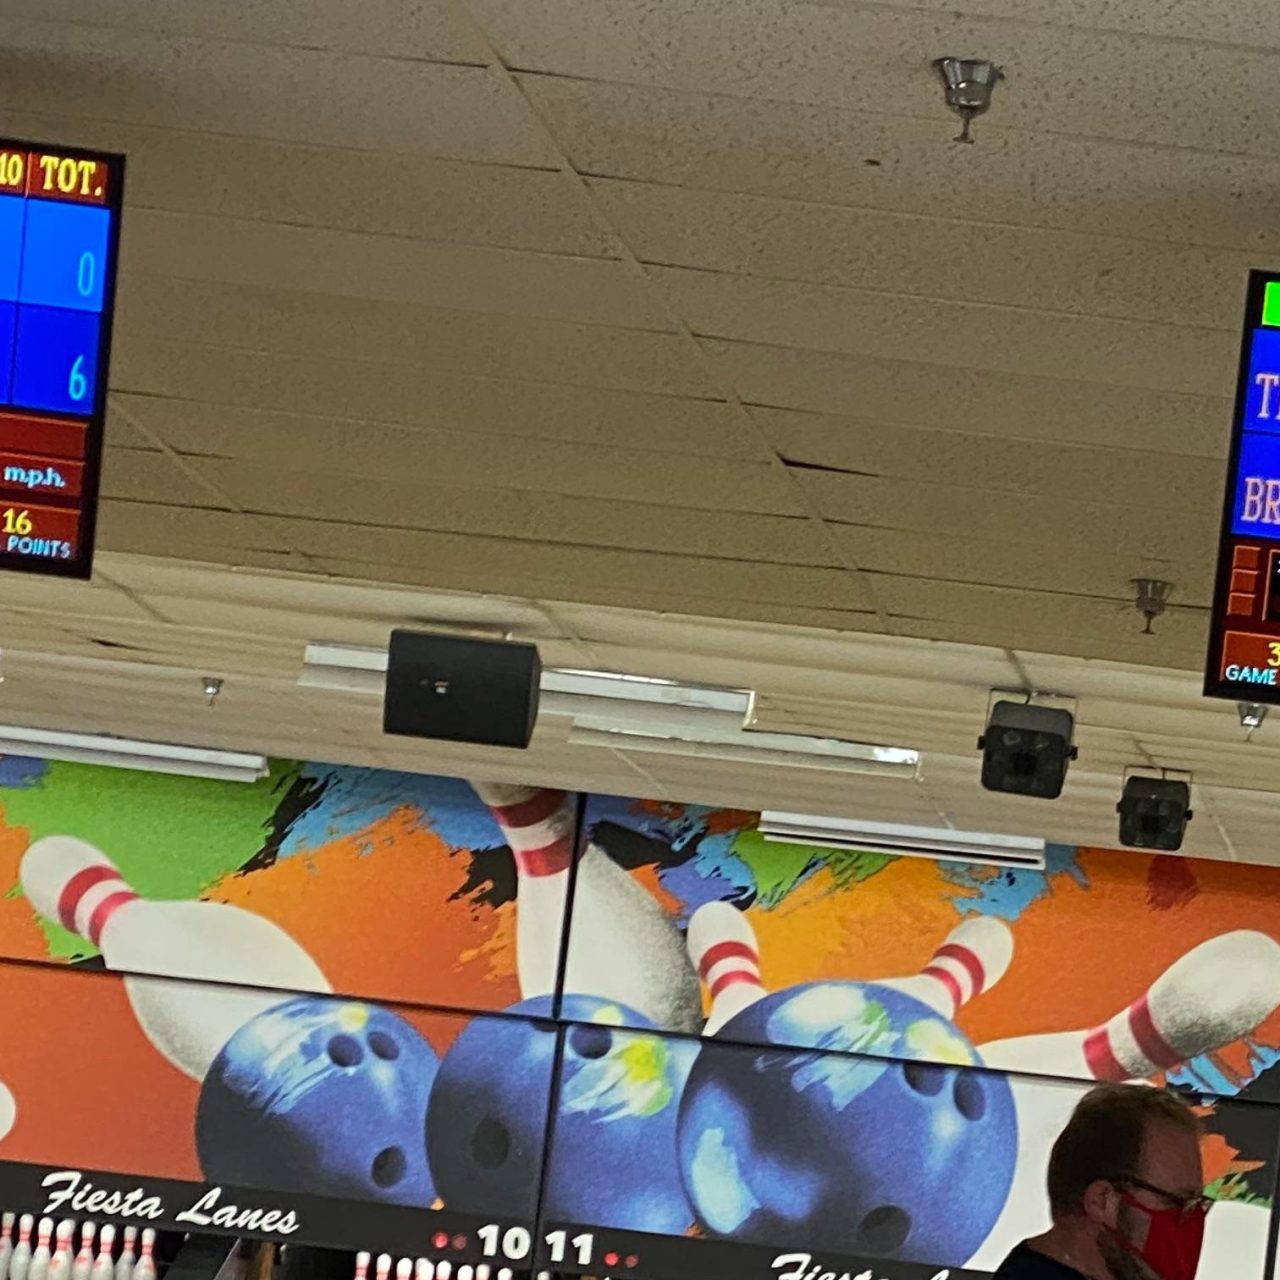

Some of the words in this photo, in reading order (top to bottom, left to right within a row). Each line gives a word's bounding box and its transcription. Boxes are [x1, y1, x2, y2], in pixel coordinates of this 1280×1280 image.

[40, 154, 103, 197] TOT.
[78, 251, 95, 296] 0
[68, 355, 87, 400] 6
[3, 465, 66, 490] m.p.h.
[2, 508, 32, 535] 16
[7, 537, 72, 559] POINTS
[1225, 664, 1278, 685] GAME
[40, 1170, 164, 1222] Fiesta
[175, 1186, 300, 1236] Lanes
[477, 1224, 531, 1261] 10
[545, 1229, 595, 1266] 11
